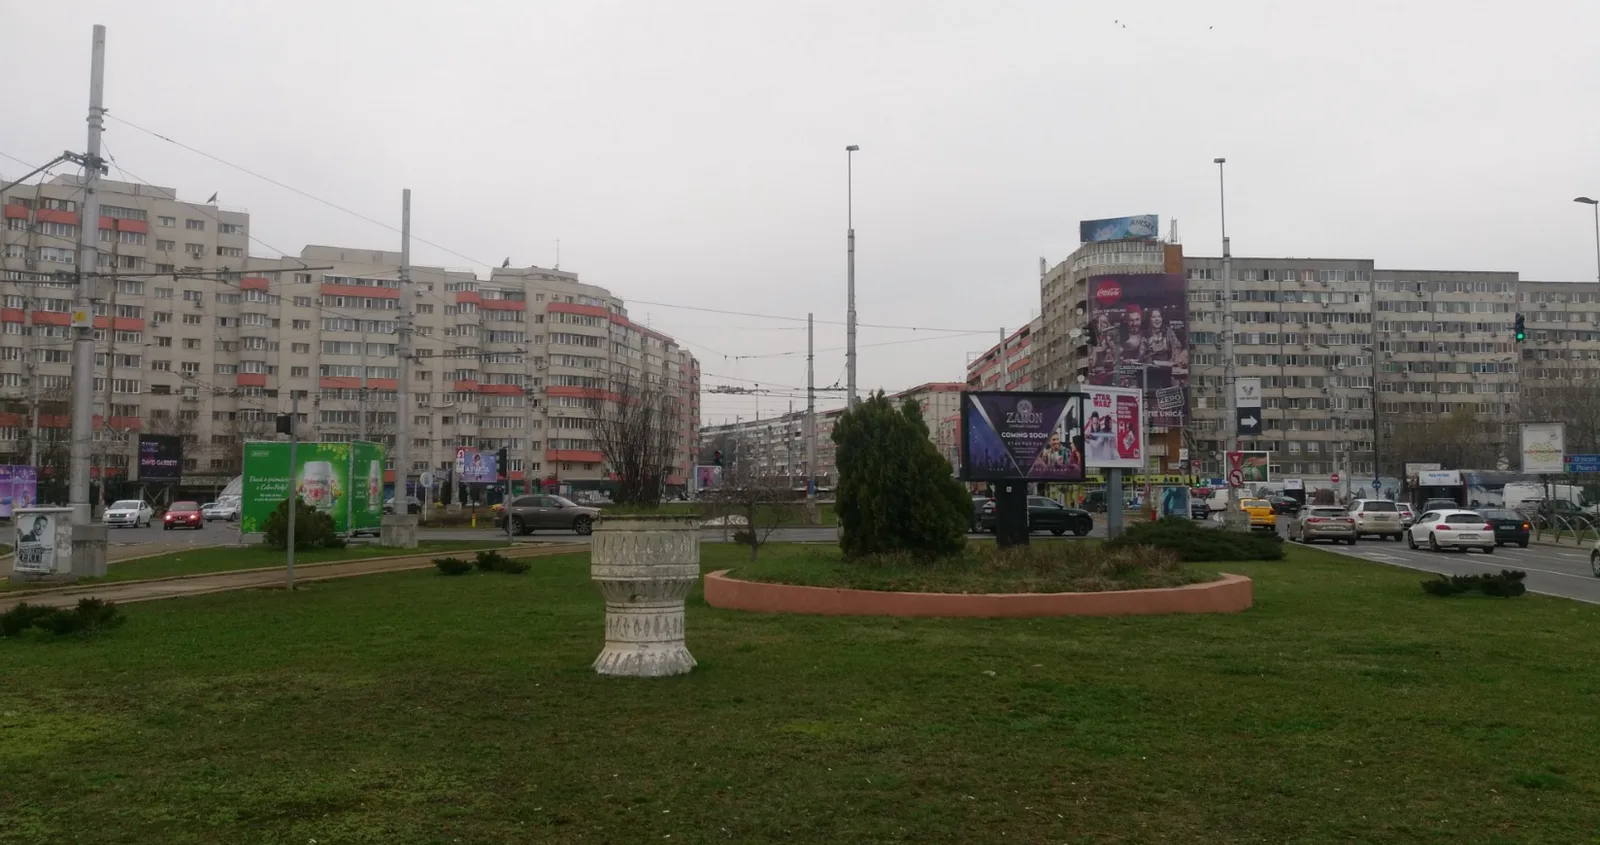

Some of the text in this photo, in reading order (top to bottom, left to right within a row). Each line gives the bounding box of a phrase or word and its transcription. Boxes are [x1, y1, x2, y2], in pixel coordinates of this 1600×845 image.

[1093, 399, 1112, 408] WARS
[1159, 394, 1181, 404] ZERO
[1006, 412, 1043, 423] ZAMON
[141, 459, 178, 467] DAVID GARRETT
